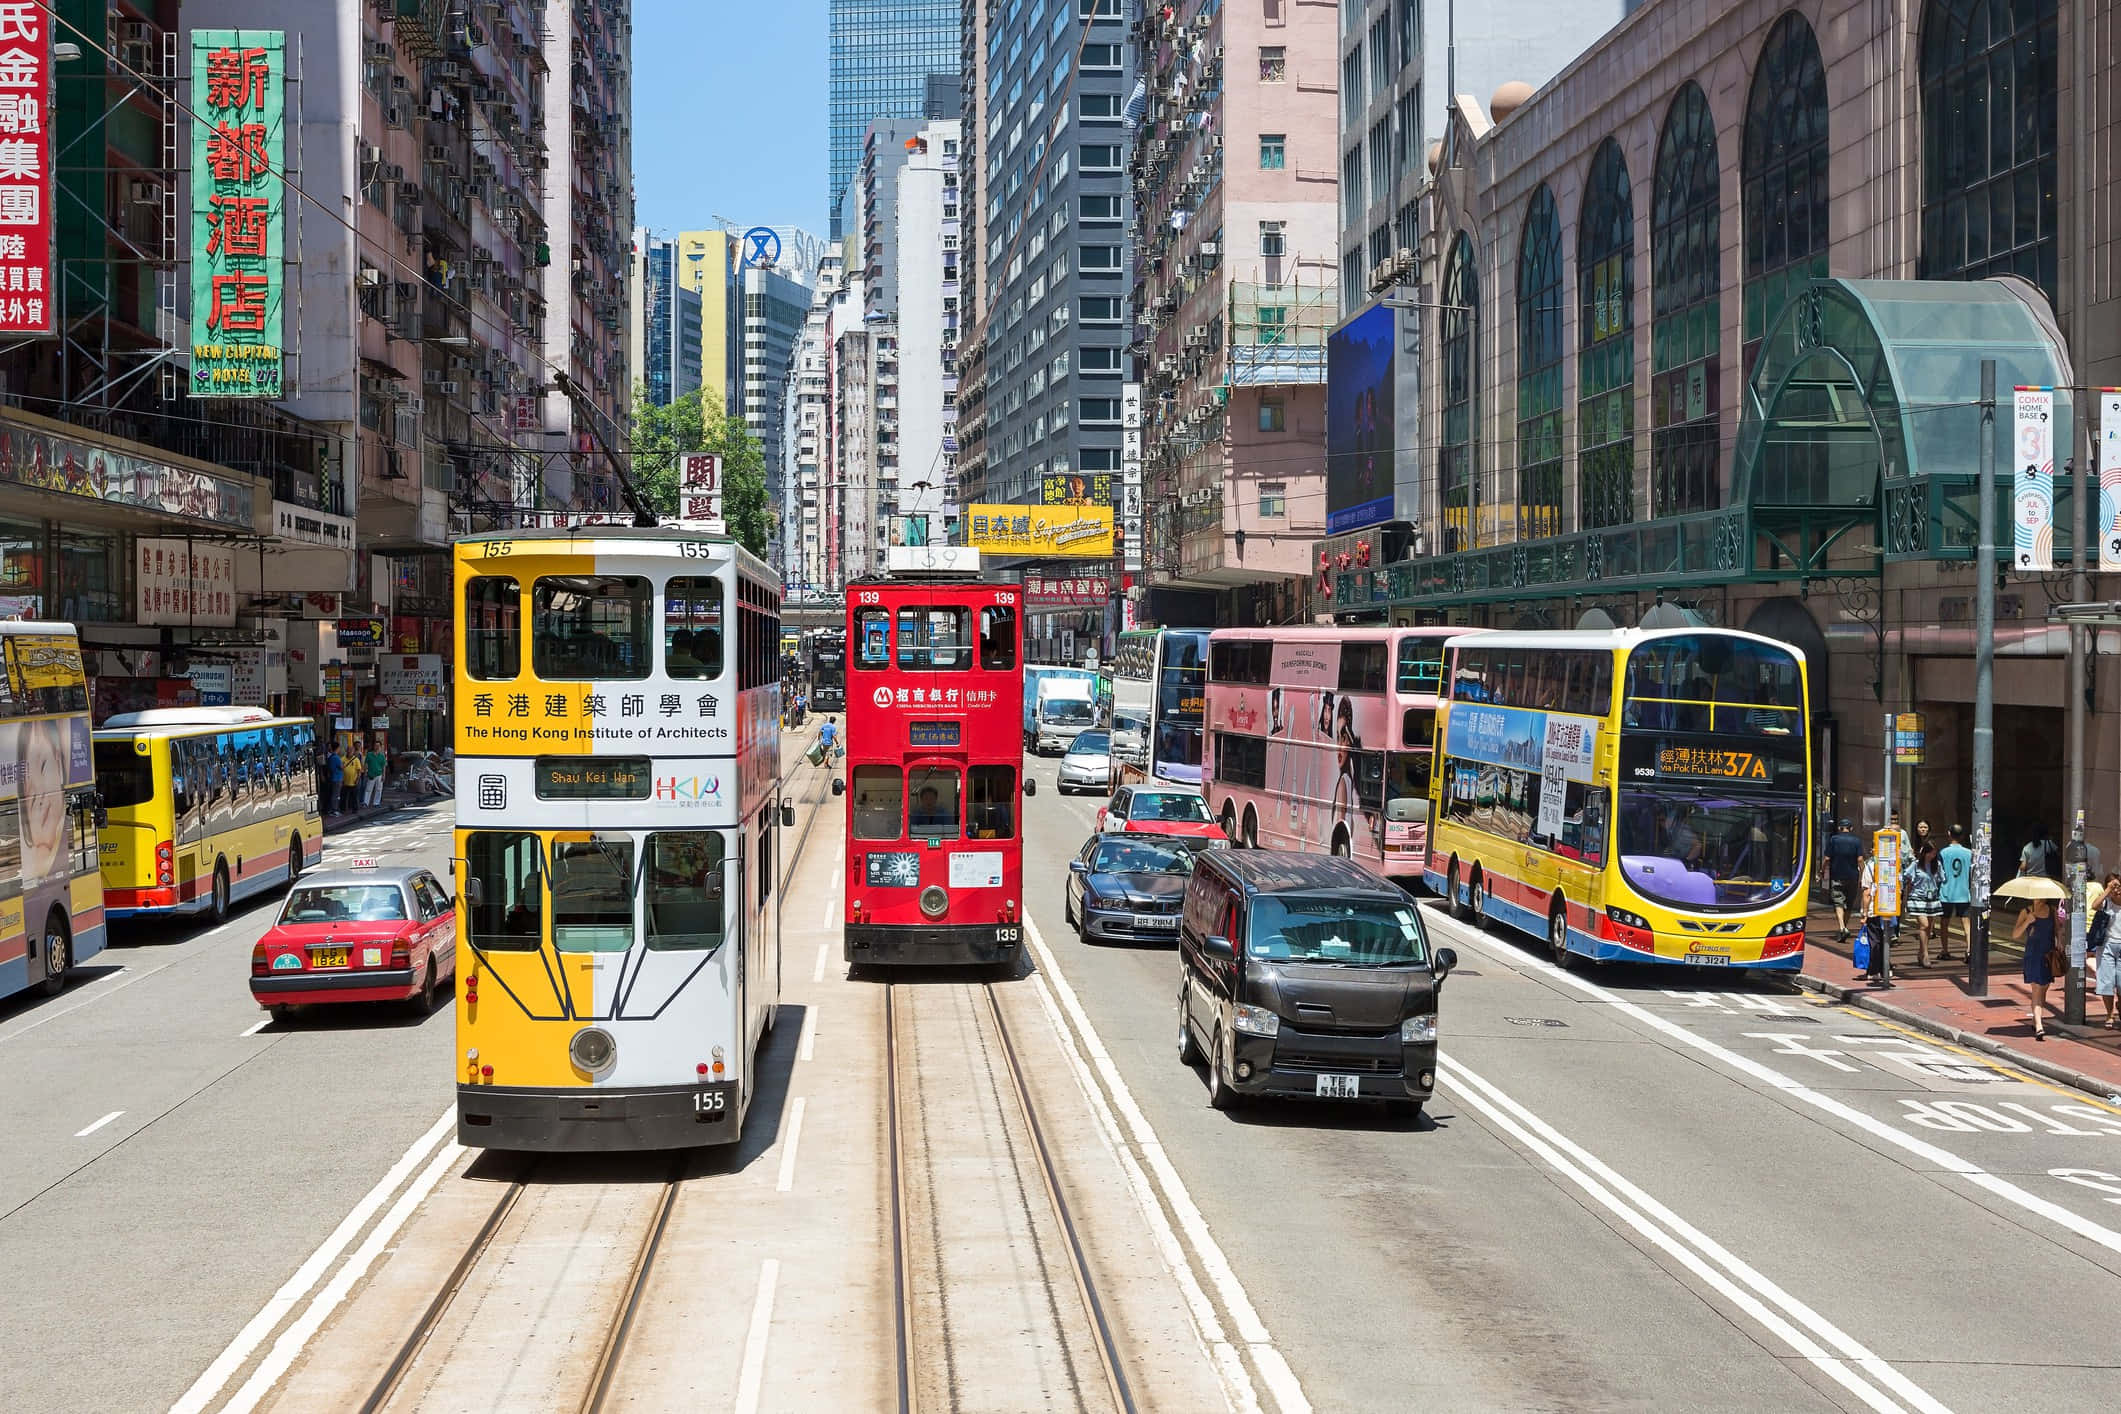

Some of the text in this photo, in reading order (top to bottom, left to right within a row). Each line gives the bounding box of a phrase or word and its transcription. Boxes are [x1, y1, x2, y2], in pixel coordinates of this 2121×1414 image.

[206, 46, 270, 332] 新都酒店
[194, 344, 279, 360] NEW CAPITAL
[212, 367, 251, 383] HOTEL
[2018, 396, 2049, 404] COMIX
[2018, 404, 2044, 412] HOME
[2018, 412, 2040, 420] BASE
[2025, 500, 2039, 509] JUL
[972, 514, 1031, 536] 日本城
[2026, 517, 2040, 525] SEP
[482, 542, 513, 559] 155
[677, 542, 710, 559] 155
[858, 592, 880, 604] 139
[993, 592, 1015, 605] 139
[896, 687, 998, 703] 招商銀行 信用卡
[473, 693, 720, 719] 香港建築師學會
[465, 726, 728, 741] The Hong Kong Institute of Architects
[1673, 764, 1690, 774] Pok
[1691, 765, 1704, 774] Fu
[1704, 766, 1723, 775] Lam
[1723, 751, 1766, 778] 37A
[551, 771, 636, 784] Shau Kei Wan
[353, 859, 376, 867] TAXI
[1951, 857, 1964, 879] 9
[994, 928, 1018, 942] 139
[315, 957, 345, 966] 1824
[692, 1091, 724, 1112] 155
